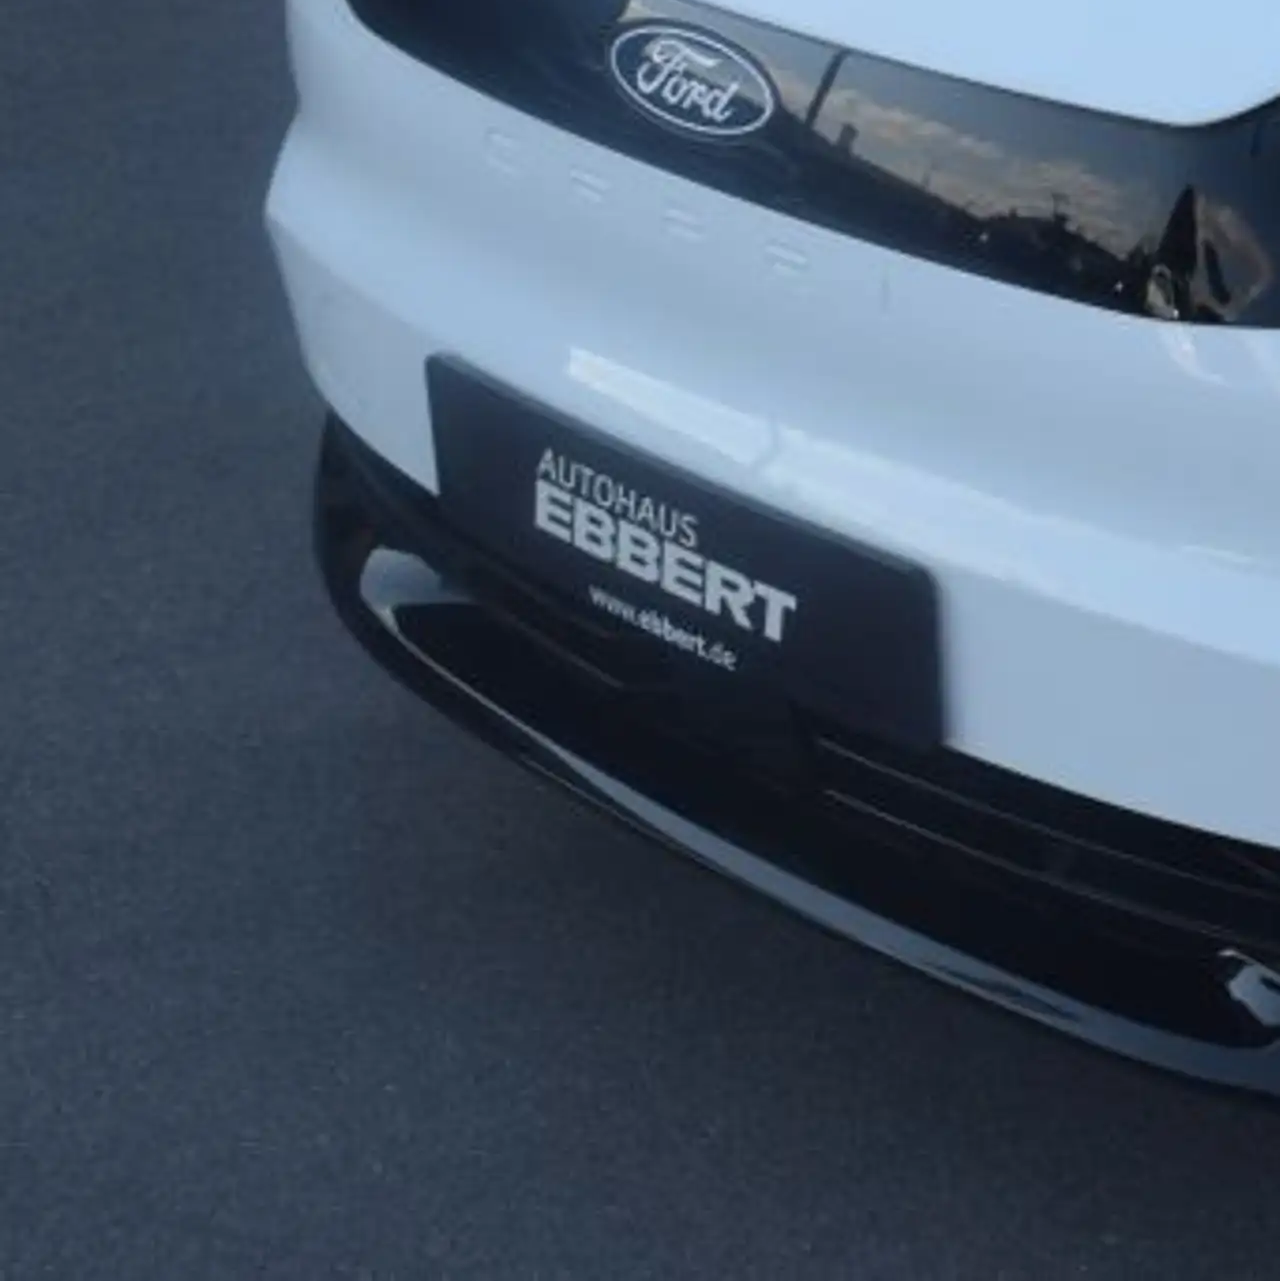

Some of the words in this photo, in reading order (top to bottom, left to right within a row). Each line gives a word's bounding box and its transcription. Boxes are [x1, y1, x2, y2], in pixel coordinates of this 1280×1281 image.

[636, 38, 739, 122] Ford
[537, 447, 699, 548] AUTOHAUS
[534, 478, 797, 643] EBBERT
[588, 583, 738, 671] www.ebbert.de
